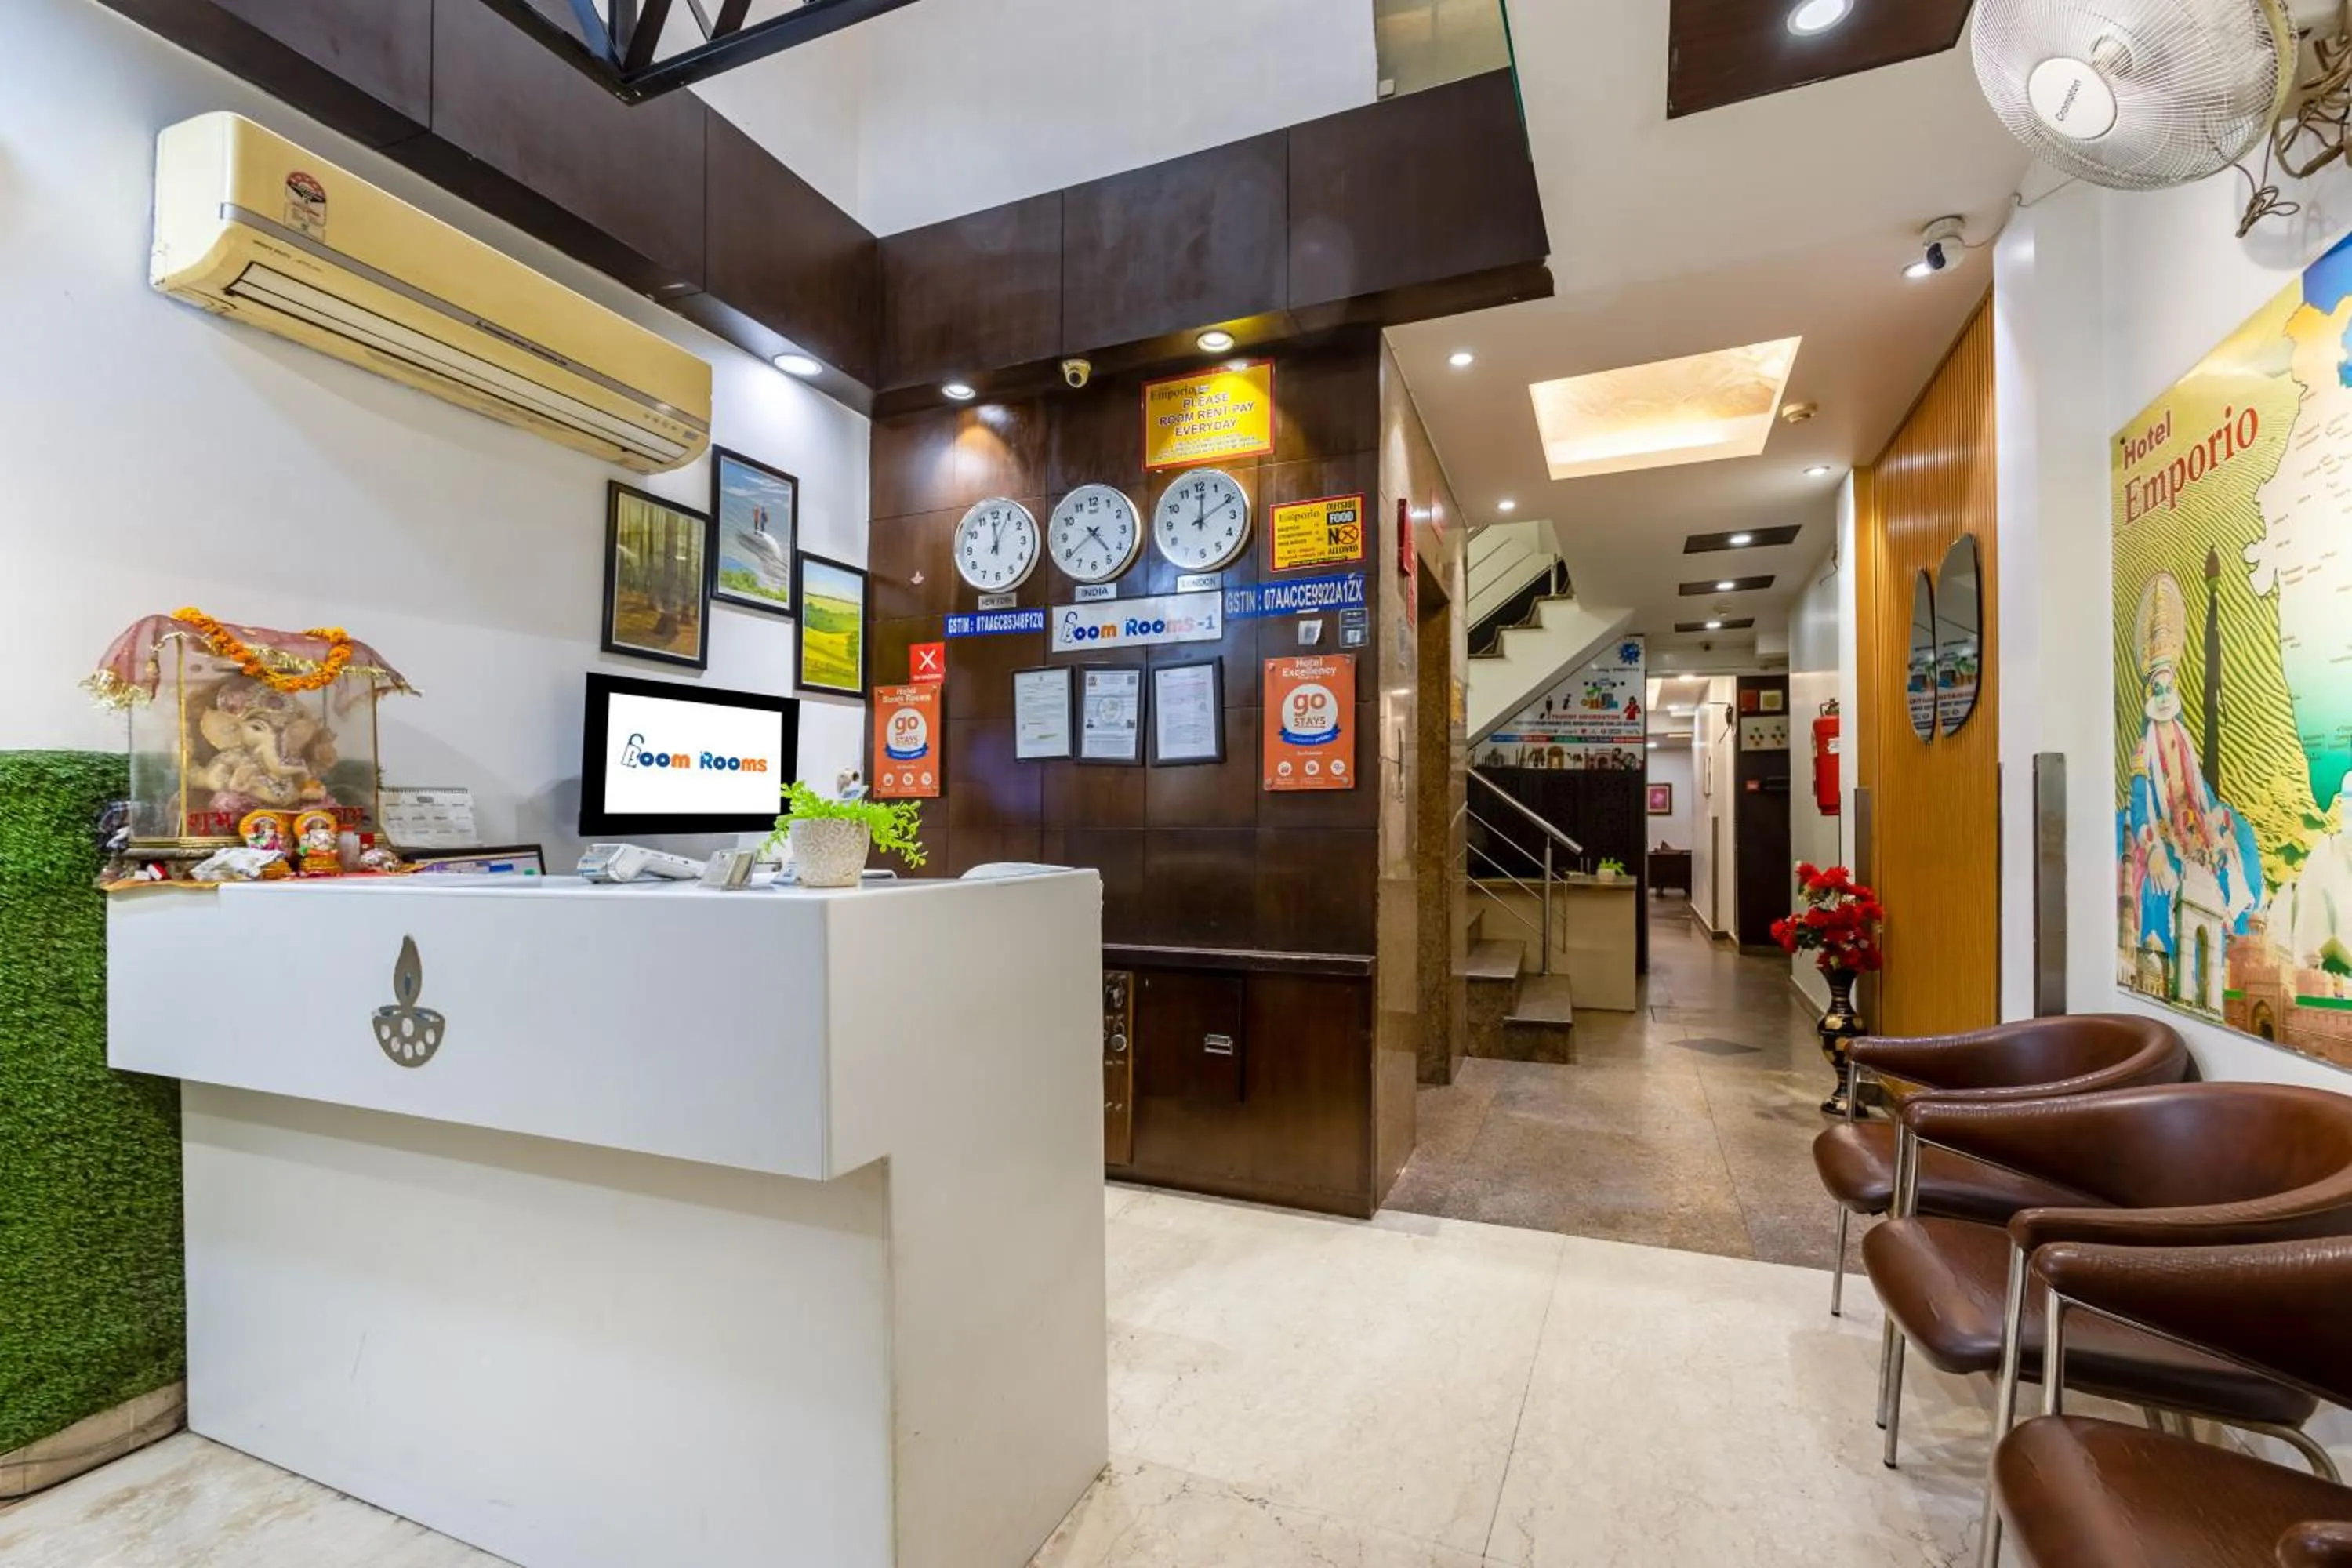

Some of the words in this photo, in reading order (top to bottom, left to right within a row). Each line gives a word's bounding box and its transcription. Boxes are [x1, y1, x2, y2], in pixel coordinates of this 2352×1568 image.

[1183, 394, 1229, 408] PLEASE
[1160, 413, 1194, 426] ROOM
[1198, 408, 1228, 420] RENT
[1232, 402, 1254, 413] PAY
[1175, 419, 1236, 437] EVERYDAY
[2124, 410, 2171, 470] Hotel
[2125, 405, 2259, 525] Emporio
[1327, 500, 1356, 510] OUTSIDE
[1329, 510, 1354, 524] FOOD
[1327, 545, 1358, 555] ALLOWED
[1081, 587, 1109, 597] INDIA
[1225, 590, 1255, 613] GSTIN
[1264, 579, 1363, 610] 07AACCE9922A1ZX
[1296, 657, 1323, 668] Hotel
[1282, 666, 1337, 678] Excellency
[1294, 693, 1327, 717] go
[895, 715, 919, 735] go
[1294, 716, 1327, 728] STAYS
[895, 735, 919, 745] STAYS
[699, 751, 768, 772] Rooms
